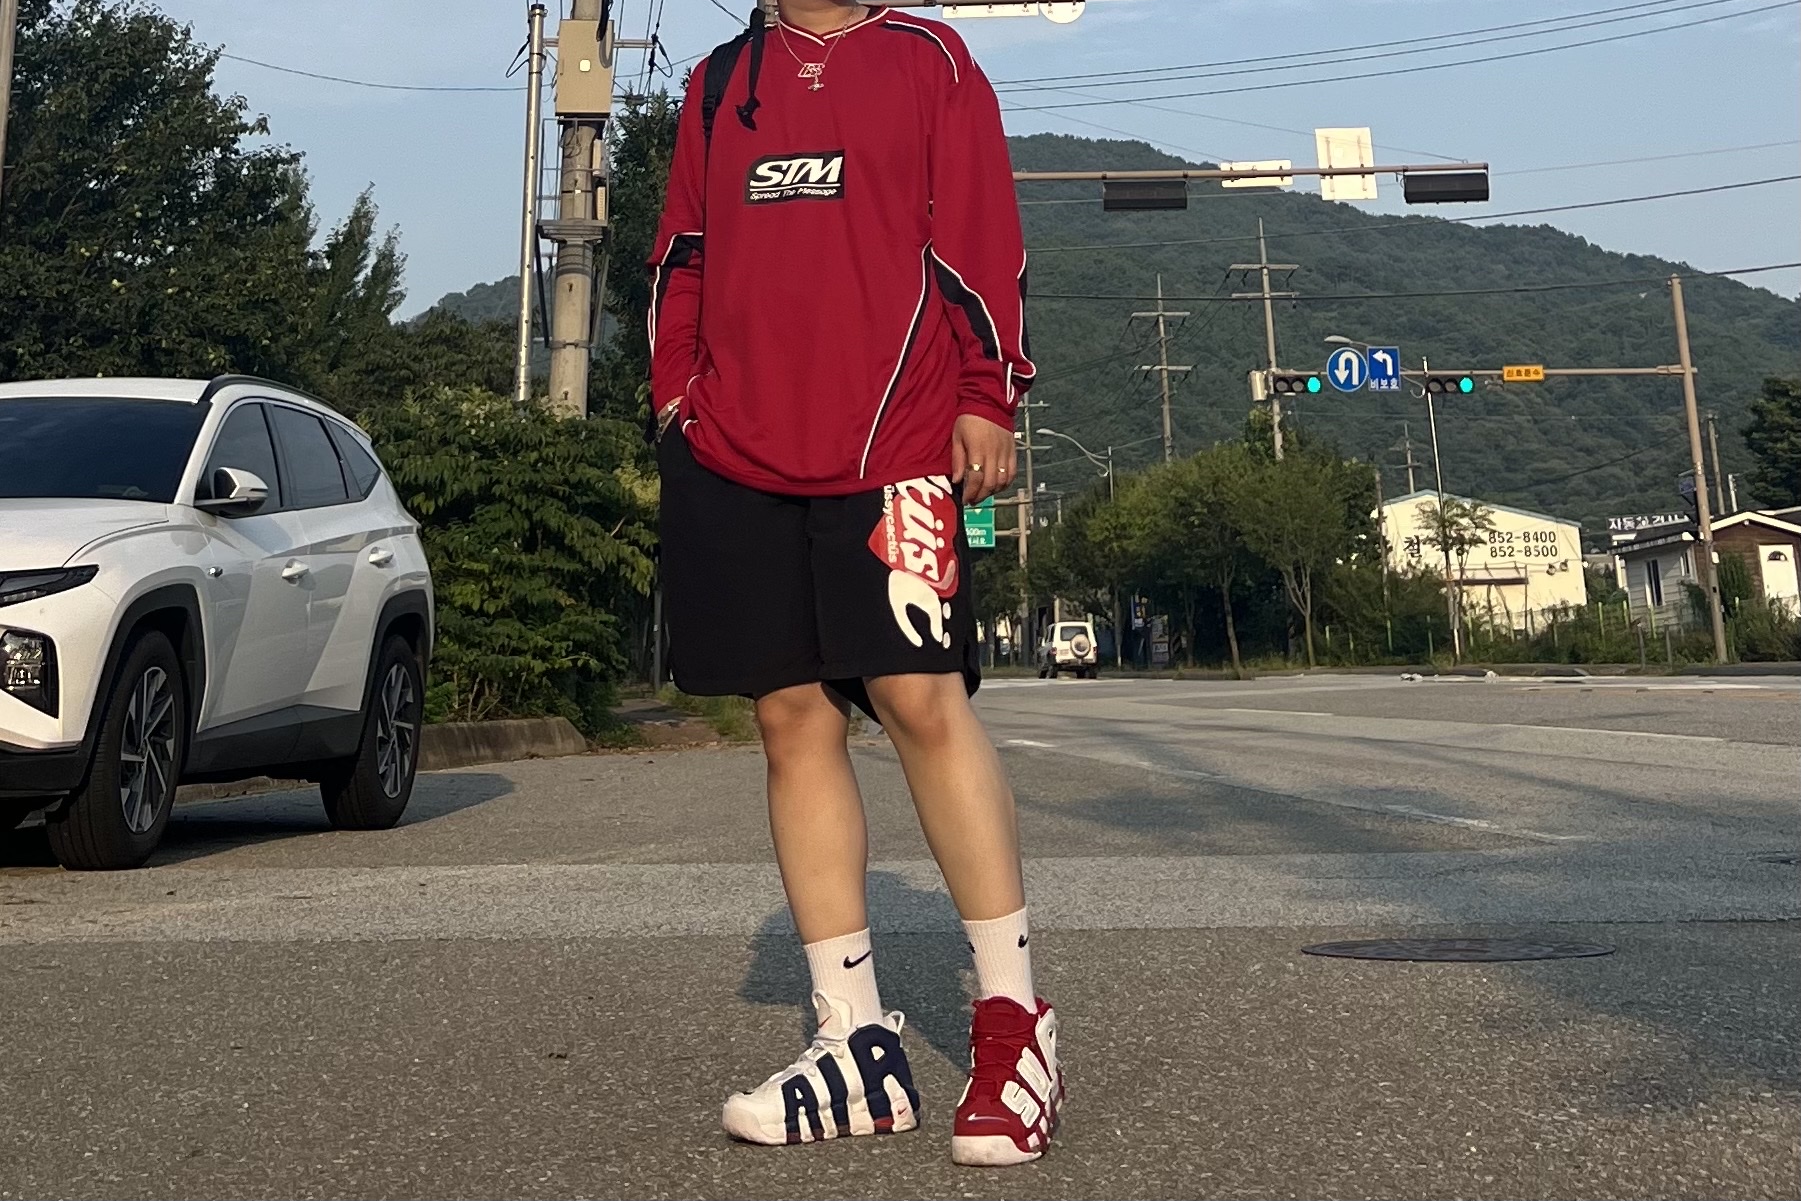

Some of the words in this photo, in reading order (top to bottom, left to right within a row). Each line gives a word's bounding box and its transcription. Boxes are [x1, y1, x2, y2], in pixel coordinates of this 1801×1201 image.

[750, 156, 843, 186] STM
[750, 192, 781, 200] Spread
[783, 189, 796, 197] The
[797, 188, 837, 196] Message
[1370, 377, 1399, 391] 비보호
[1488, 531, 1557, 544] 852-8400
[1490, 545, 1558, 558] 852-8500
[782, 1023, 920, 1144] AIR
